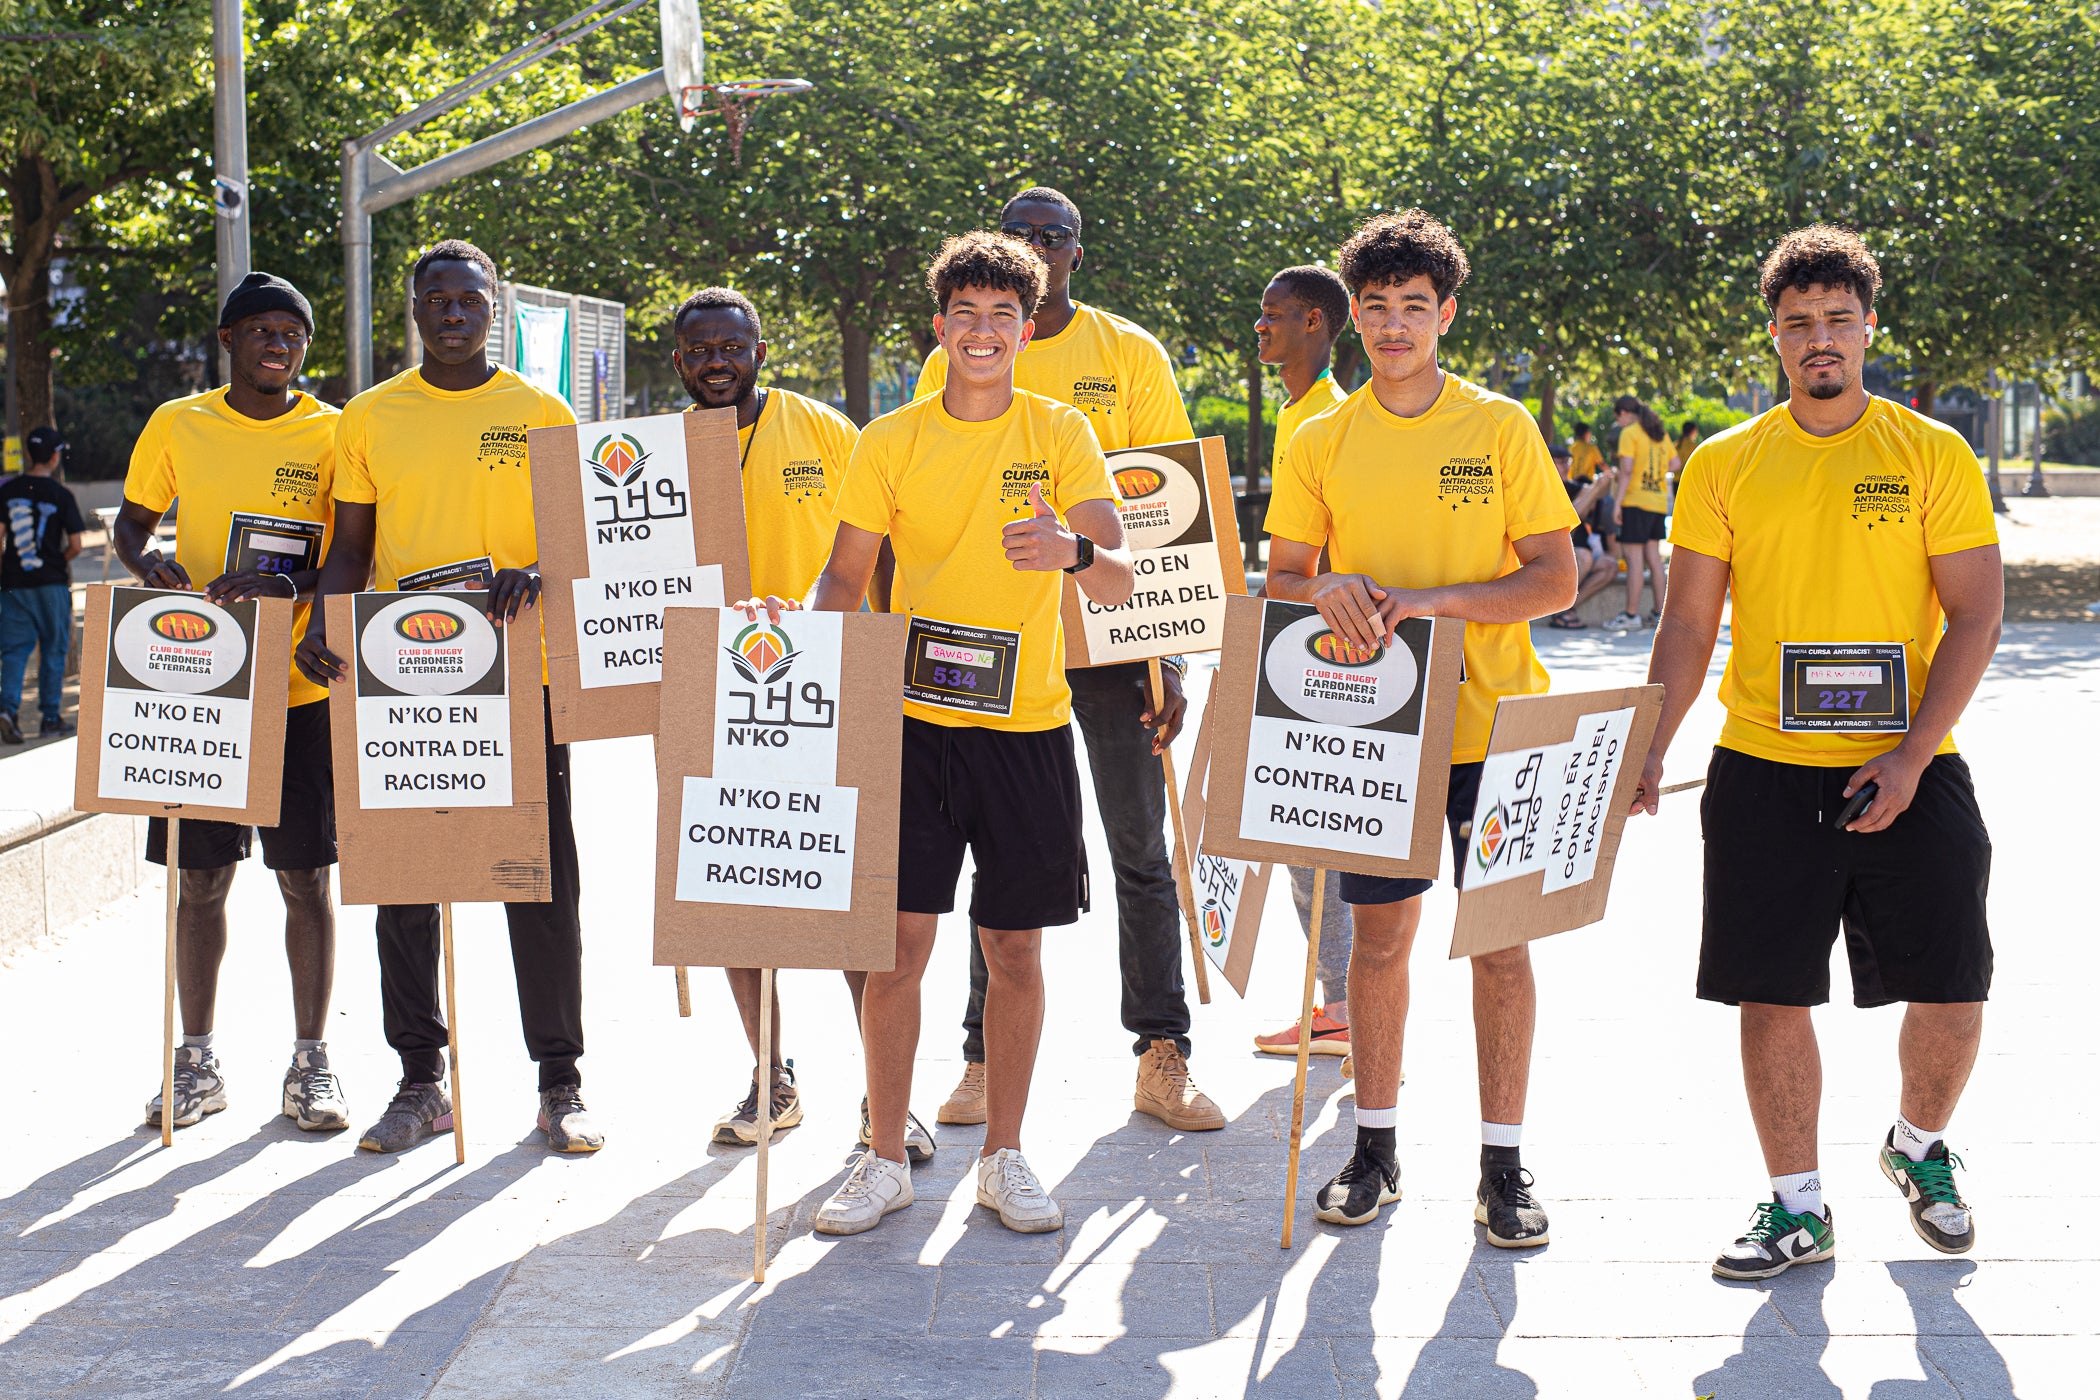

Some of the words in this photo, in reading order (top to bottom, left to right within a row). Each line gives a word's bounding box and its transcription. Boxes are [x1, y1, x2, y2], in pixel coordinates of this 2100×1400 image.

[1074, 382, 1116, 393] CURSA
[1073, 397, 1116, 406] TERRASSA
[481, 432, 527, 443] CURSA
[479, 448, 526, 459] TERRASSA
[1450, 457, 1486, 465] PRIMERA
[285, 461, 316, 470] PRIMERA
[783, 467, 824, 476] CURSA
[1440, 465, 1493, 477] CURSA
[276, 467, 319, 482] CURSA
[1002, 470, 1049, 480] CURSA
[273, 484, 317, 497] TERRASSA
[784, 482, 827, 490] TERRASSA
[1001, 489, 1051, 497] TERRSA
[1439, 485, 1494, 494] TERRASSA
[1854, 483, 1909, 496] CURSA
[1129, 503, 1139, 511] DE
[1140, 501, 1167, 510] RUGBY
[1853, 503, 1910, 513] TERRASSA
[253, 519, 273, 527] CURSA
[1122, 509, 1169, 522] RBONERS
[598, 524, 651, 544] N'KO
[256, 554, 294, 573] 219
[1161, 554, 1190, 572] EN
[414, 575, 431, 584] CURSA
[664, 576, 692, 595] EN
[1179, 584, 1219, 603] DEL
[583, 613, 664, 636] CONTR
[930, 625, 950, 634] CURSA
[1109, 618, 1206, 644] RACISMO
[149, 653, 212, 666] CARBONERS
[150, 645, 172, 653] CLUB
[173, 646, 183, 654] DE
[185, 647, 213, 657] RUGBY
[434, 648, 463, 656] RUGBY
[604, 647, 663, 668] RACIS
[933, 646, 974, 663] JAWAD
[148, 662, 160, 670] DE
[162, 662, 211, 674] TERRASSA
[399, 656, 463, 665] CARBONERS
[933, 666, 977, 689] 534
[1305, 669, 1331, 679] CLUB
[1332, 672, 1343, 680] DE
[1345, 674, 1378, 684] RUGBY
[1305, 678, 1377, 695] CARBONERS
[921, 692, 942, 701] CURSA
[1303, 688, 1317, 698] DE
[1318, 690, 1375, 705] TERRASSA
[1819, 690, 1868, 709] 227
[193, 706, 221, 724] EN
[450, 707, 478, 724] EN
[108, 732, 197, 755] CONTRA
[202, 740, 242, 760] DEL
[728, 727, 789, 748] N'KO
[365, 741, 457, 758] CONTRA
[463, 740, 504, 757] DEL
[1352, 739, 1385, 762] EN
[1565, 752, 1582, 785] EN
[124, 766, 222, 790] RACISMO
[384, 773, 486, 791] RACISMO
[1254, 765, 1355, 796] CONTRA
[1362, 779, 1408, 803] DEL
[788, 792, 821, 813] EN
[1564, 773, 1593, 879] CONTRA
[1587, 720, 1609, 766] DEL
[1583, 739, 1617, 854] RACISMO
[1270, 804, 1383, 837] RACISMO
[1524, 796, 1542, 860] N'KO
[689, 824, 792, 850] CONTRA
[799, 831, 846, 854] DEL
[706, 863, 822, 890] RACISMO
